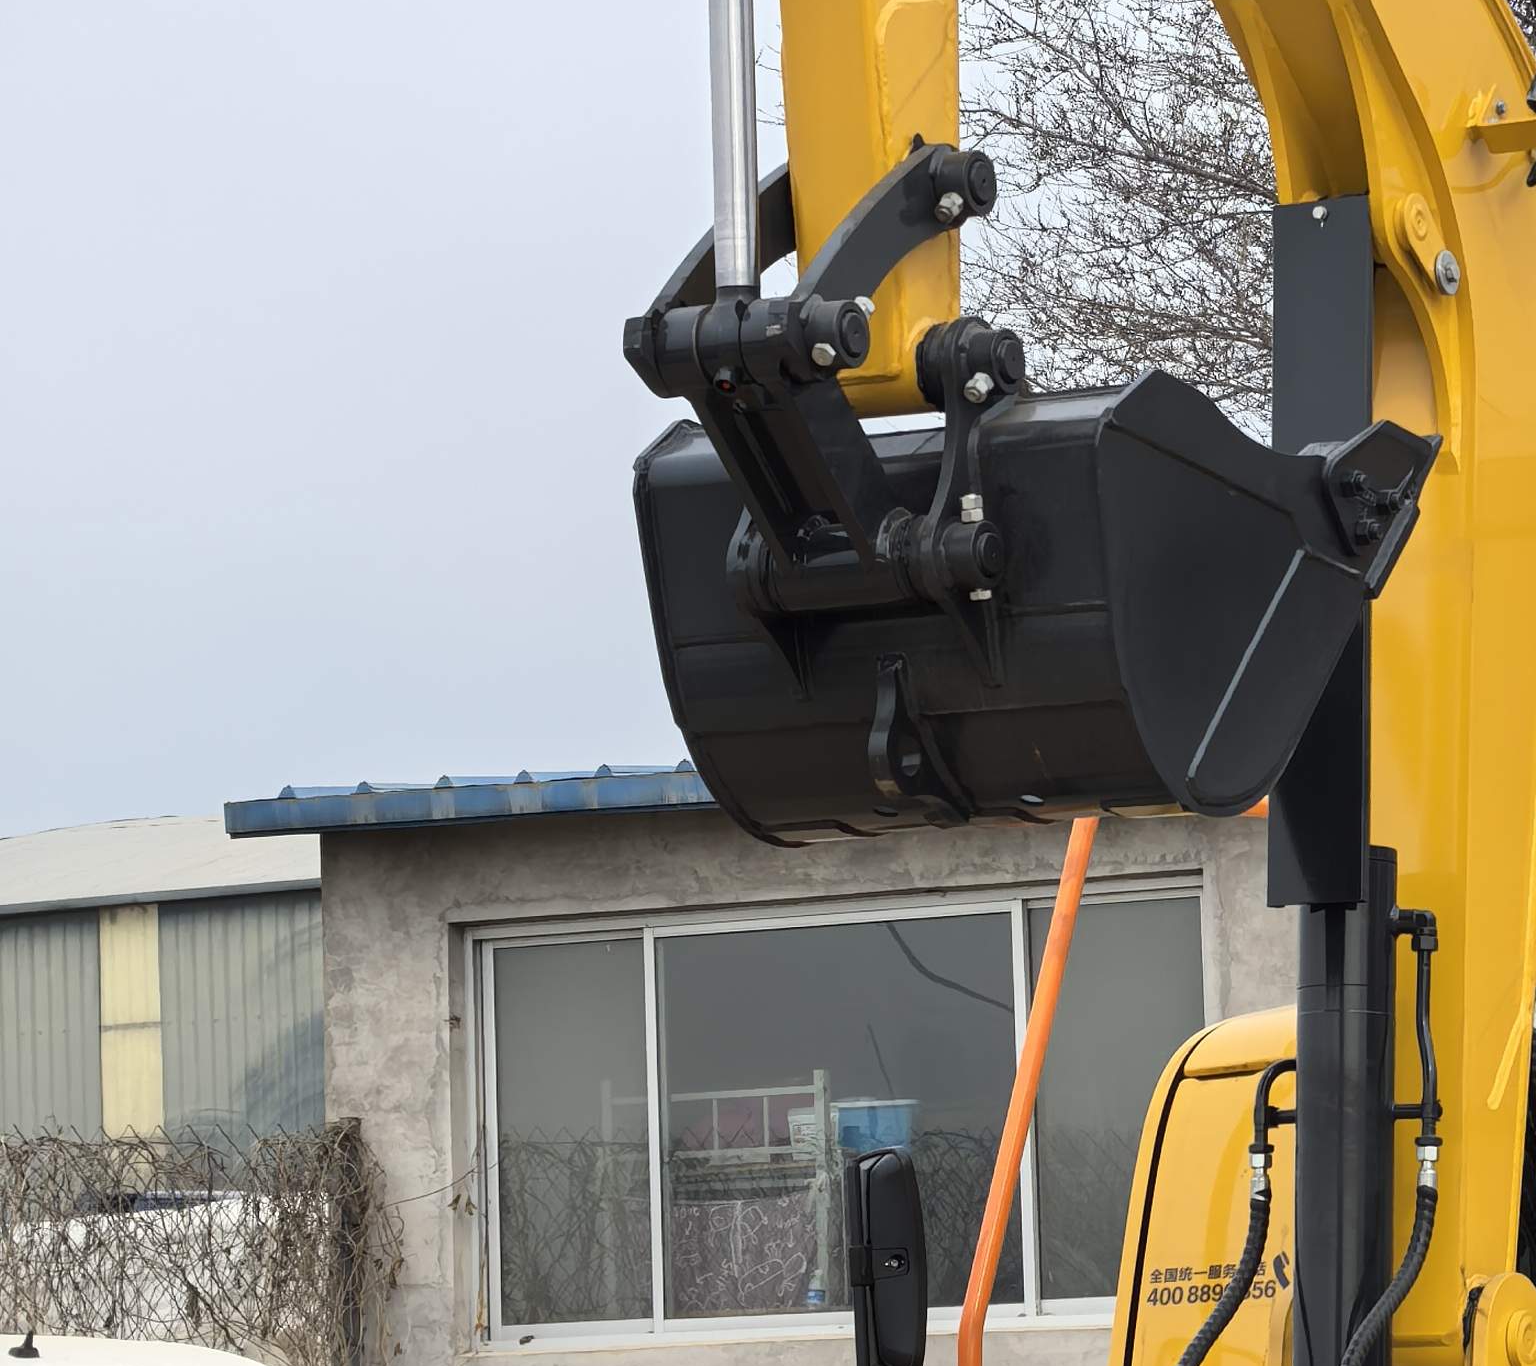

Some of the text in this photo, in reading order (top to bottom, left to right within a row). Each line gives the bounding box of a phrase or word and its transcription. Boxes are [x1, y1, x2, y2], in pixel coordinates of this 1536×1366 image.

[1150, 1261, 1267, 1284] 全国统一服务话
[1147, 1280, 1277, 1306] 400 88956
